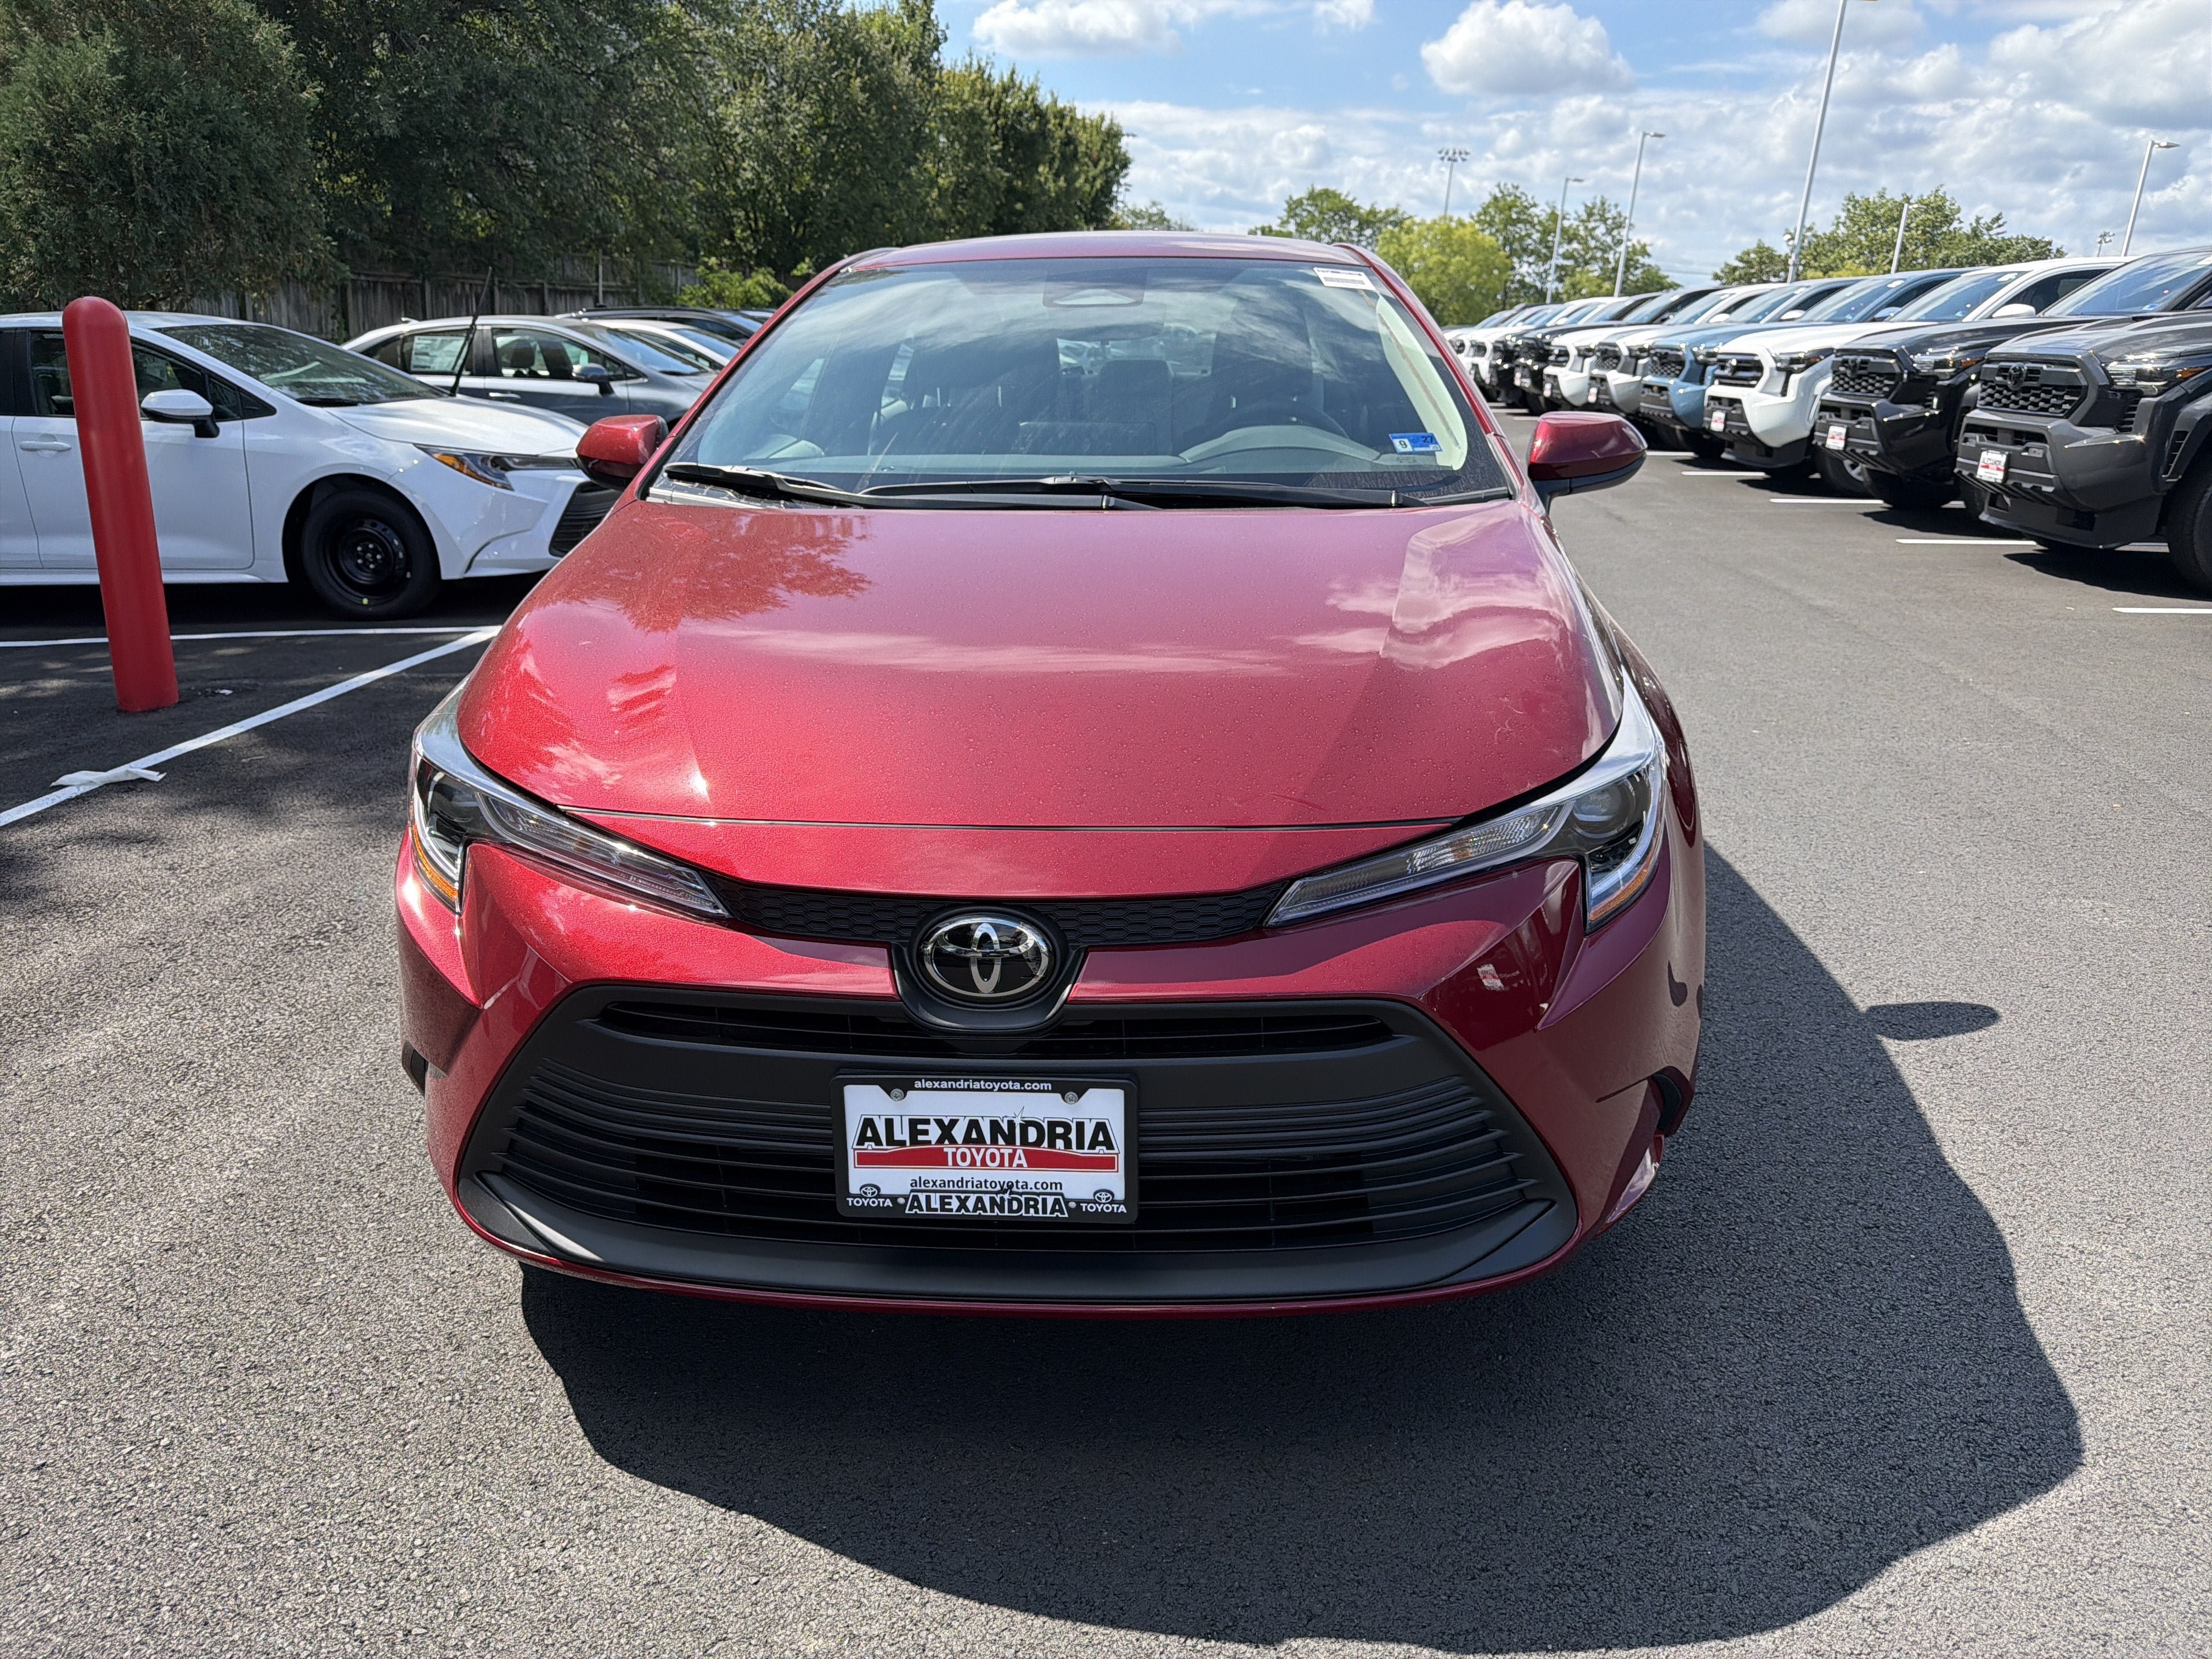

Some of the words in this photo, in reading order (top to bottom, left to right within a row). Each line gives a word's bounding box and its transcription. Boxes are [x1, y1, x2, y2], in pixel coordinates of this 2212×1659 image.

[1398, 440, 1408, 448] 9
[914, 1079, 1052, 1091] alexandriatoyota.com
[856, 1117, 1116, 1150] ALEXANDRIA
[944, 1147, 1028, 1167] TOYOTA
[910, 1177, 1063, 1192] alexandriatoyota.com
[847, 1198, 893, 1207] TOYOTA
[907, 1194, 1066, 1216] ALEXANDRIA
[1081, 1203, 1127, 1214] TOYOTA
